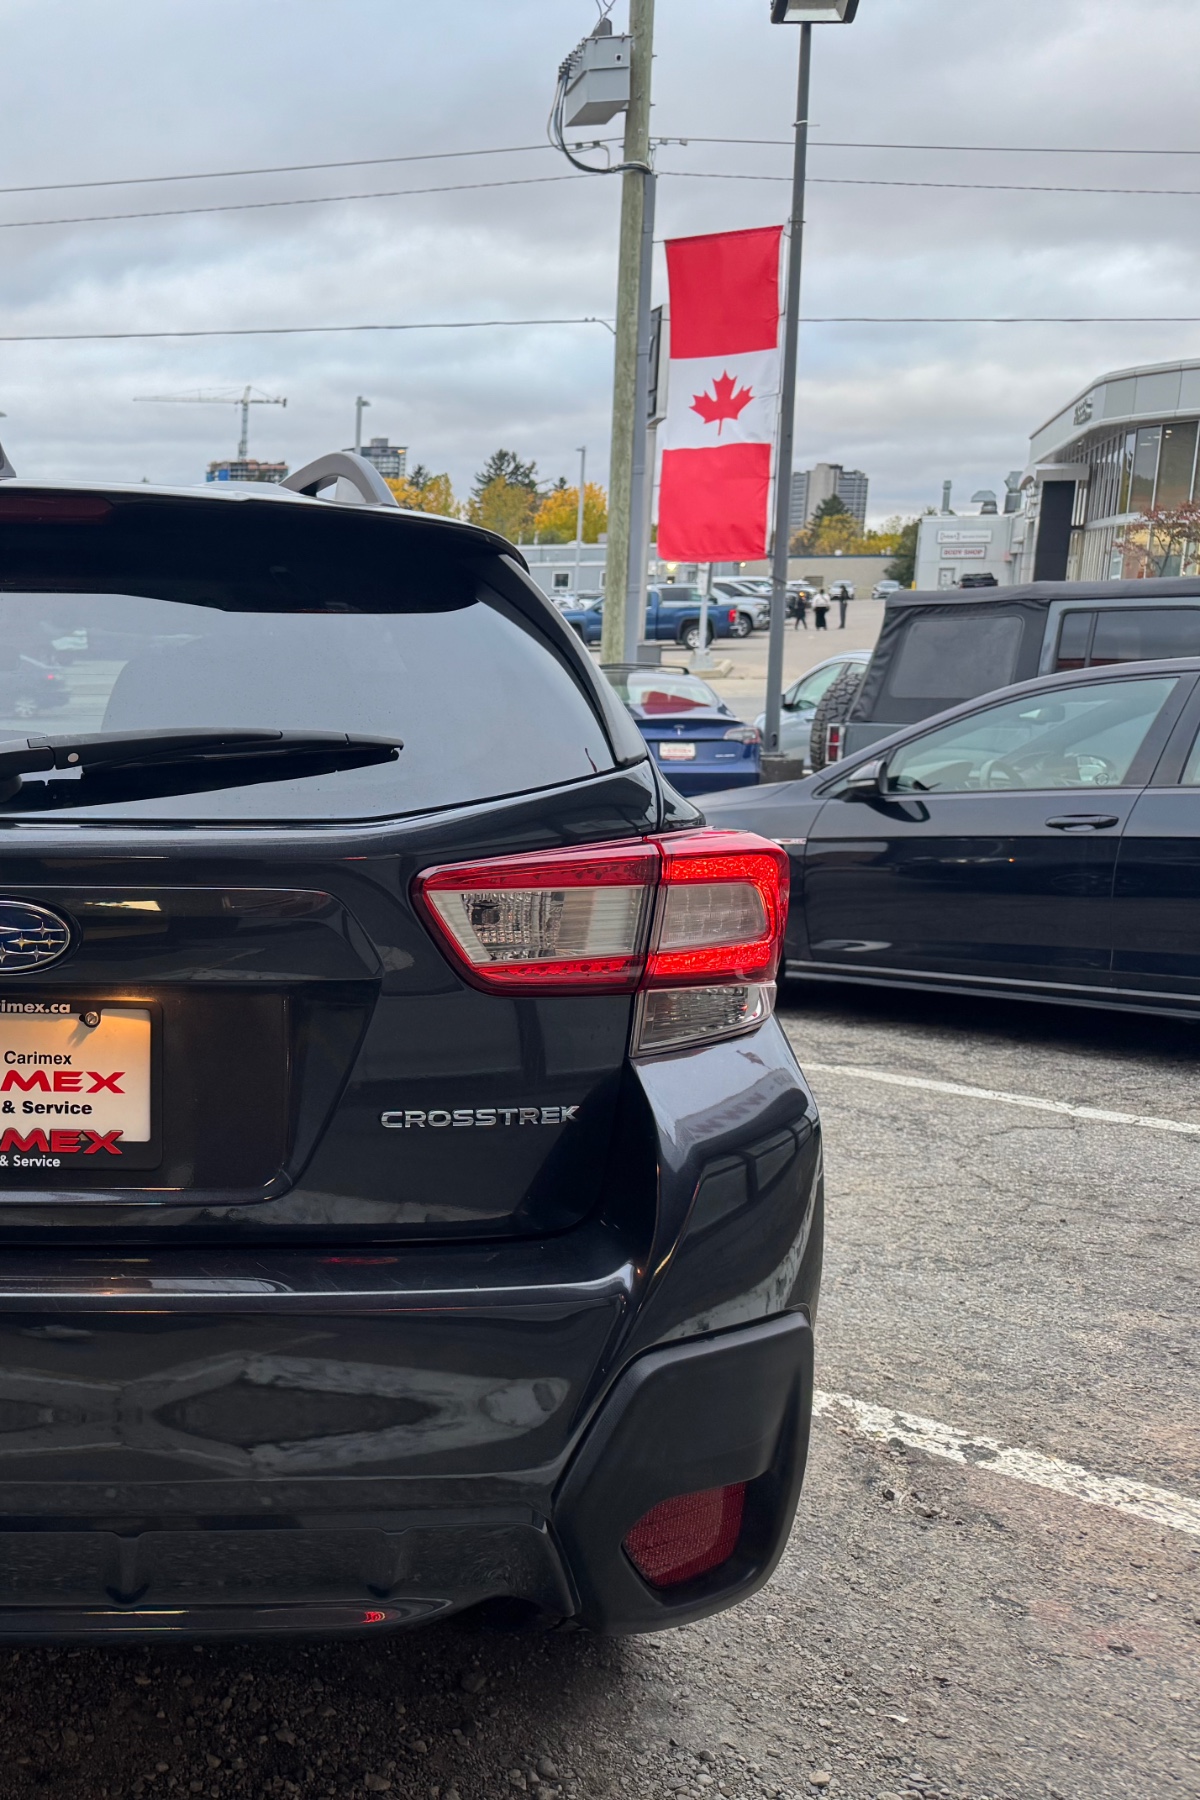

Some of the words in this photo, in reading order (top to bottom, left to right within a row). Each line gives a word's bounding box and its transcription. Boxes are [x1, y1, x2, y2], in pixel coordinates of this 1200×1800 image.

[3, 1050, 72, 1065] Carimex
[1, 1100, 16, 1115] &
[22, 1100, 93, 1115] Service
[380, 1105, 580, 1129] CROSSTREK
[13, 1154, 61, 1168] Service
